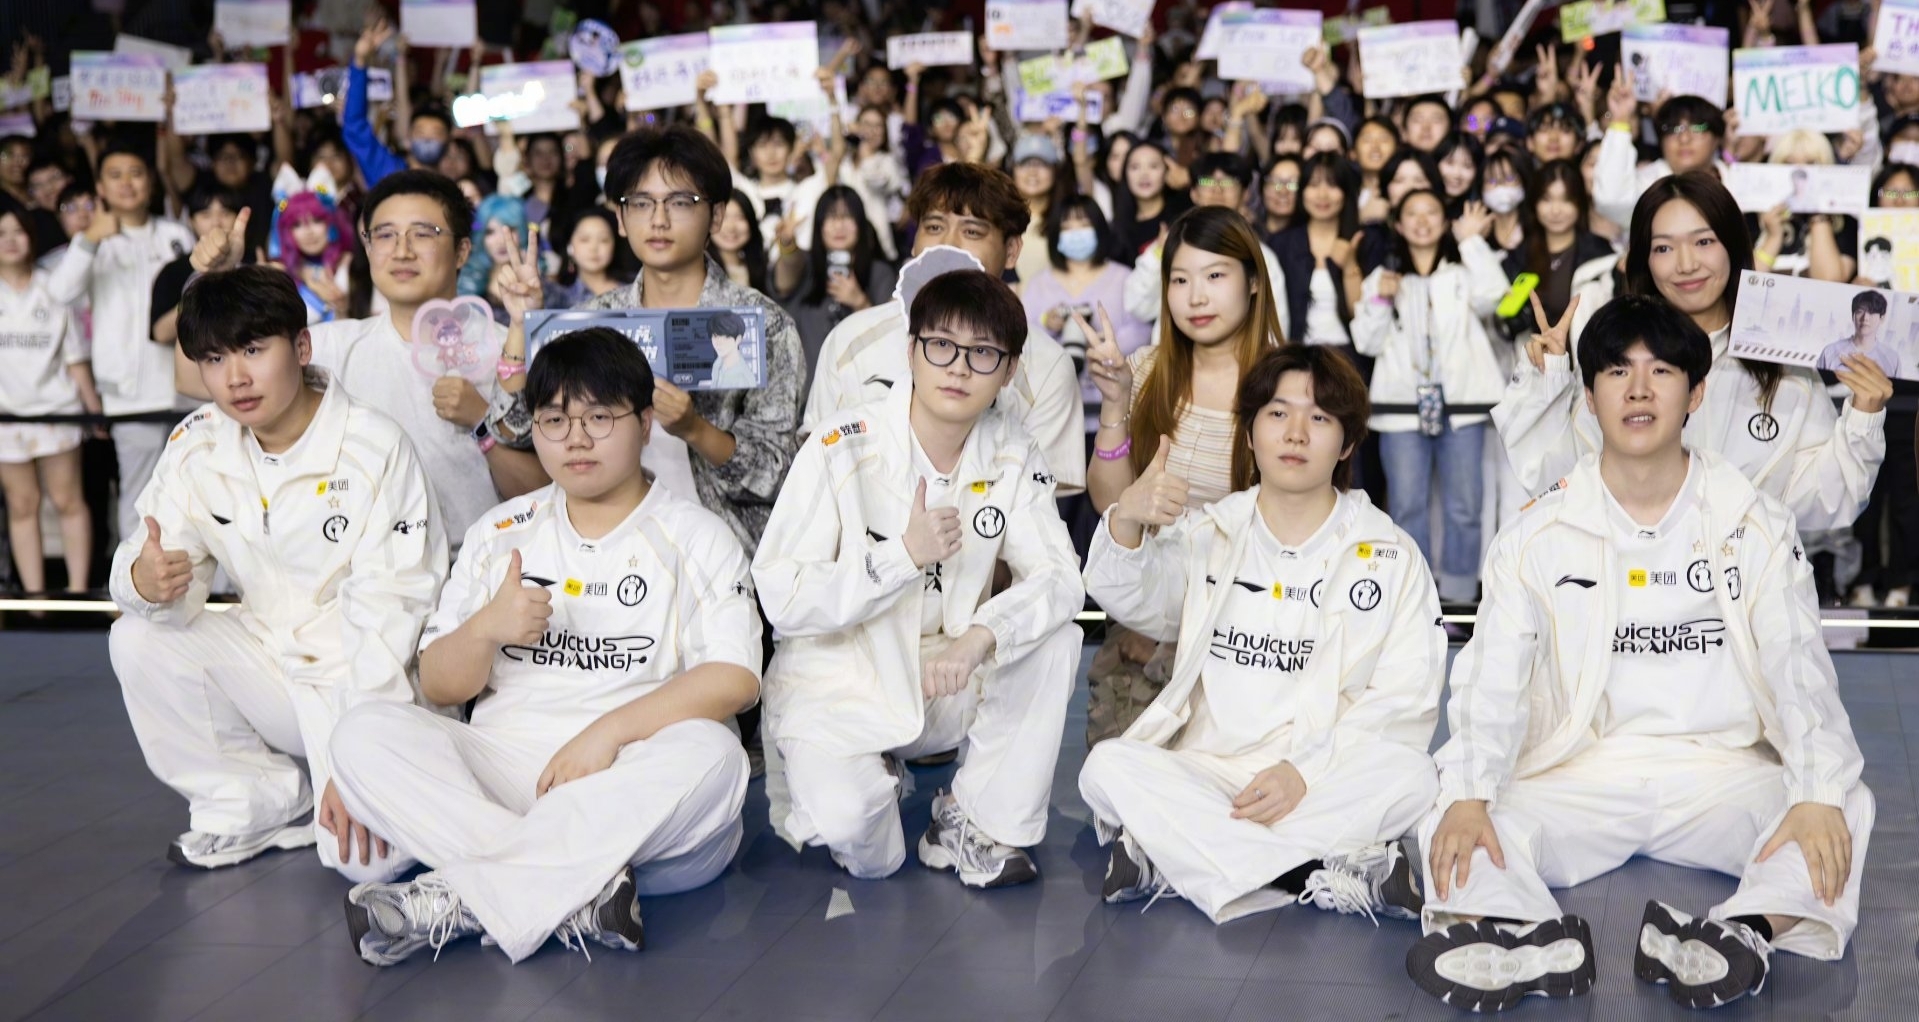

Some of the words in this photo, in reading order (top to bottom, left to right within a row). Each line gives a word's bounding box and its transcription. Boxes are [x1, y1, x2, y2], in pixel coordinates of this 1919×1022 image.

[1744, 66, 1861, 117] MEIKO
[1762, 278, 1775, 288] iG
[328, 478, 349, 491] 美团
[1374, 547, 1398, 559] 美团
[1650, 571, 1677, 585] 美团
[584, 582, 608, 596] 美团
[1615, 622, 1692, 640] victus
[1235, 650, 1310, 673] GAMIN
